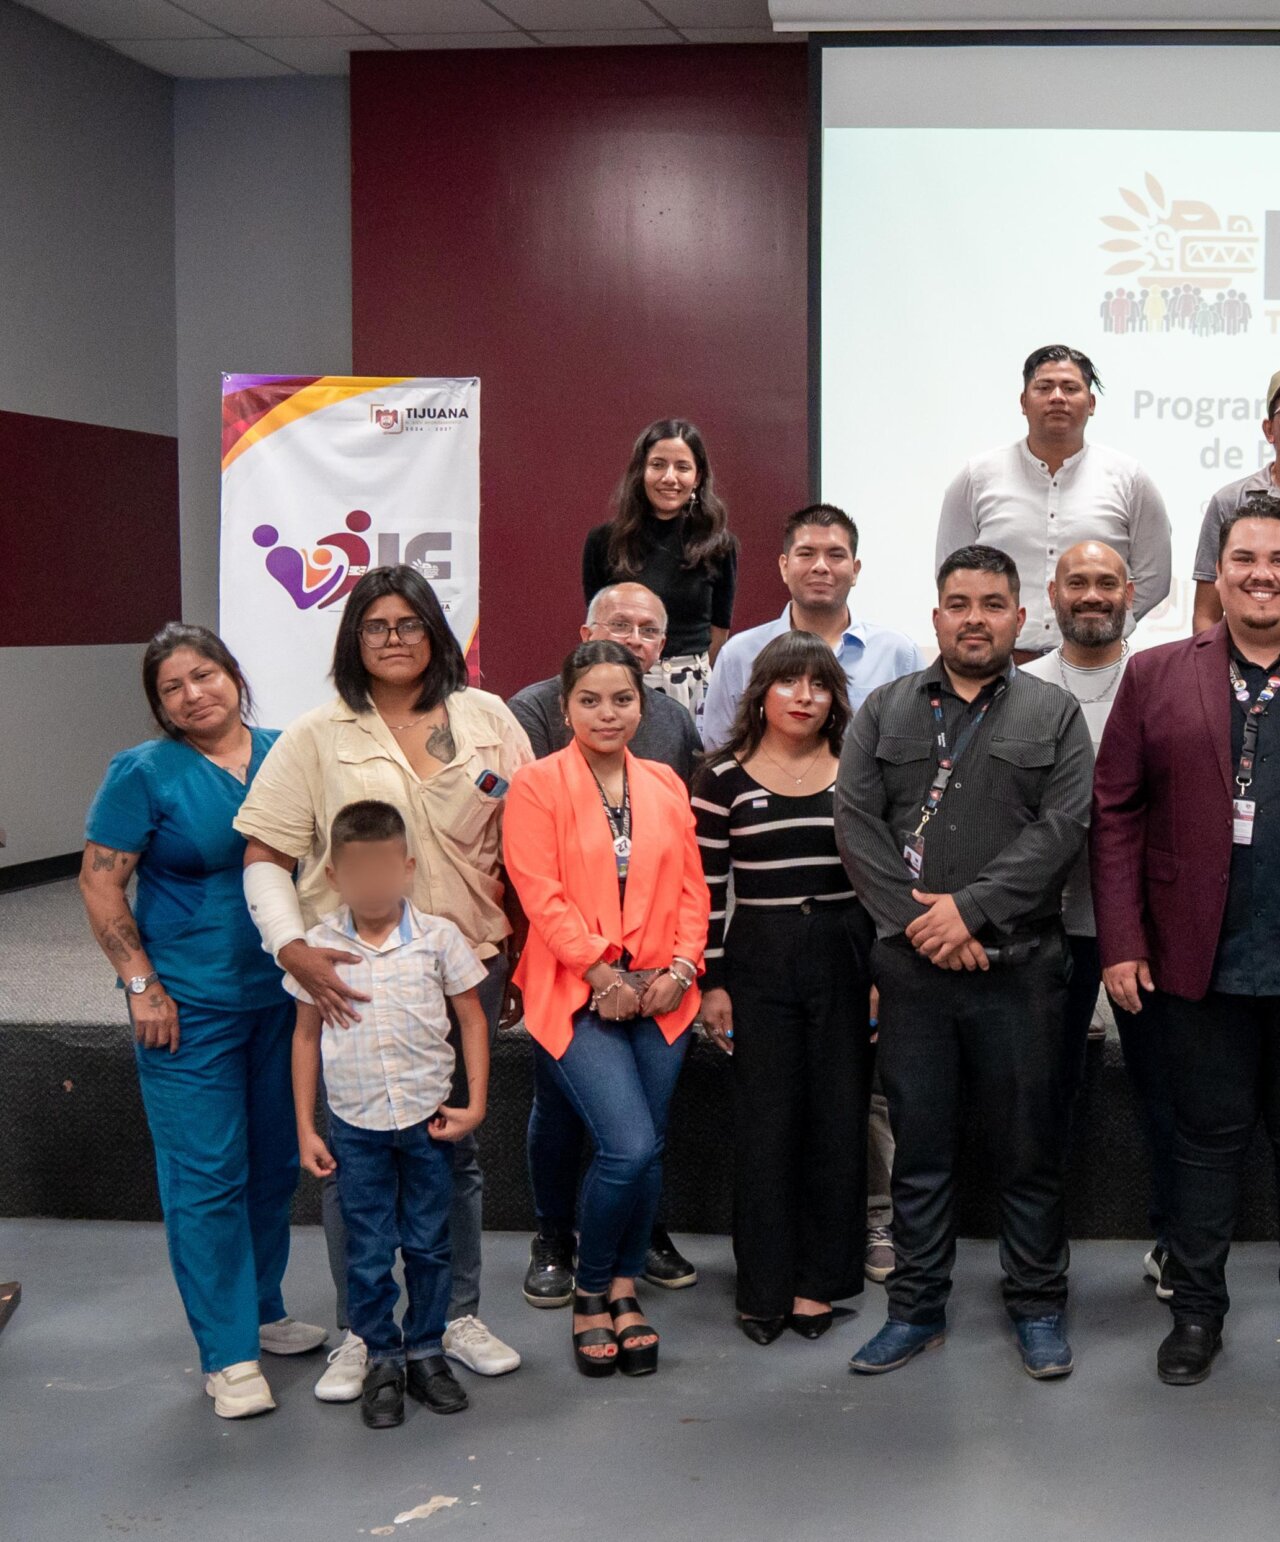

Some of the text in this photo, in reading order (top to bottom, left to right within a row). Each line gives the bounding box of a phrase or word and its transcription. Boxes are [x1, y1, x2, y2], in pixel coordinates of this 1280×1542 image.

[406, 408, 469, 419] TIJUANA
[1134, 389, 1260, 428] Progra
[1200, 437, 1244, 469] de
